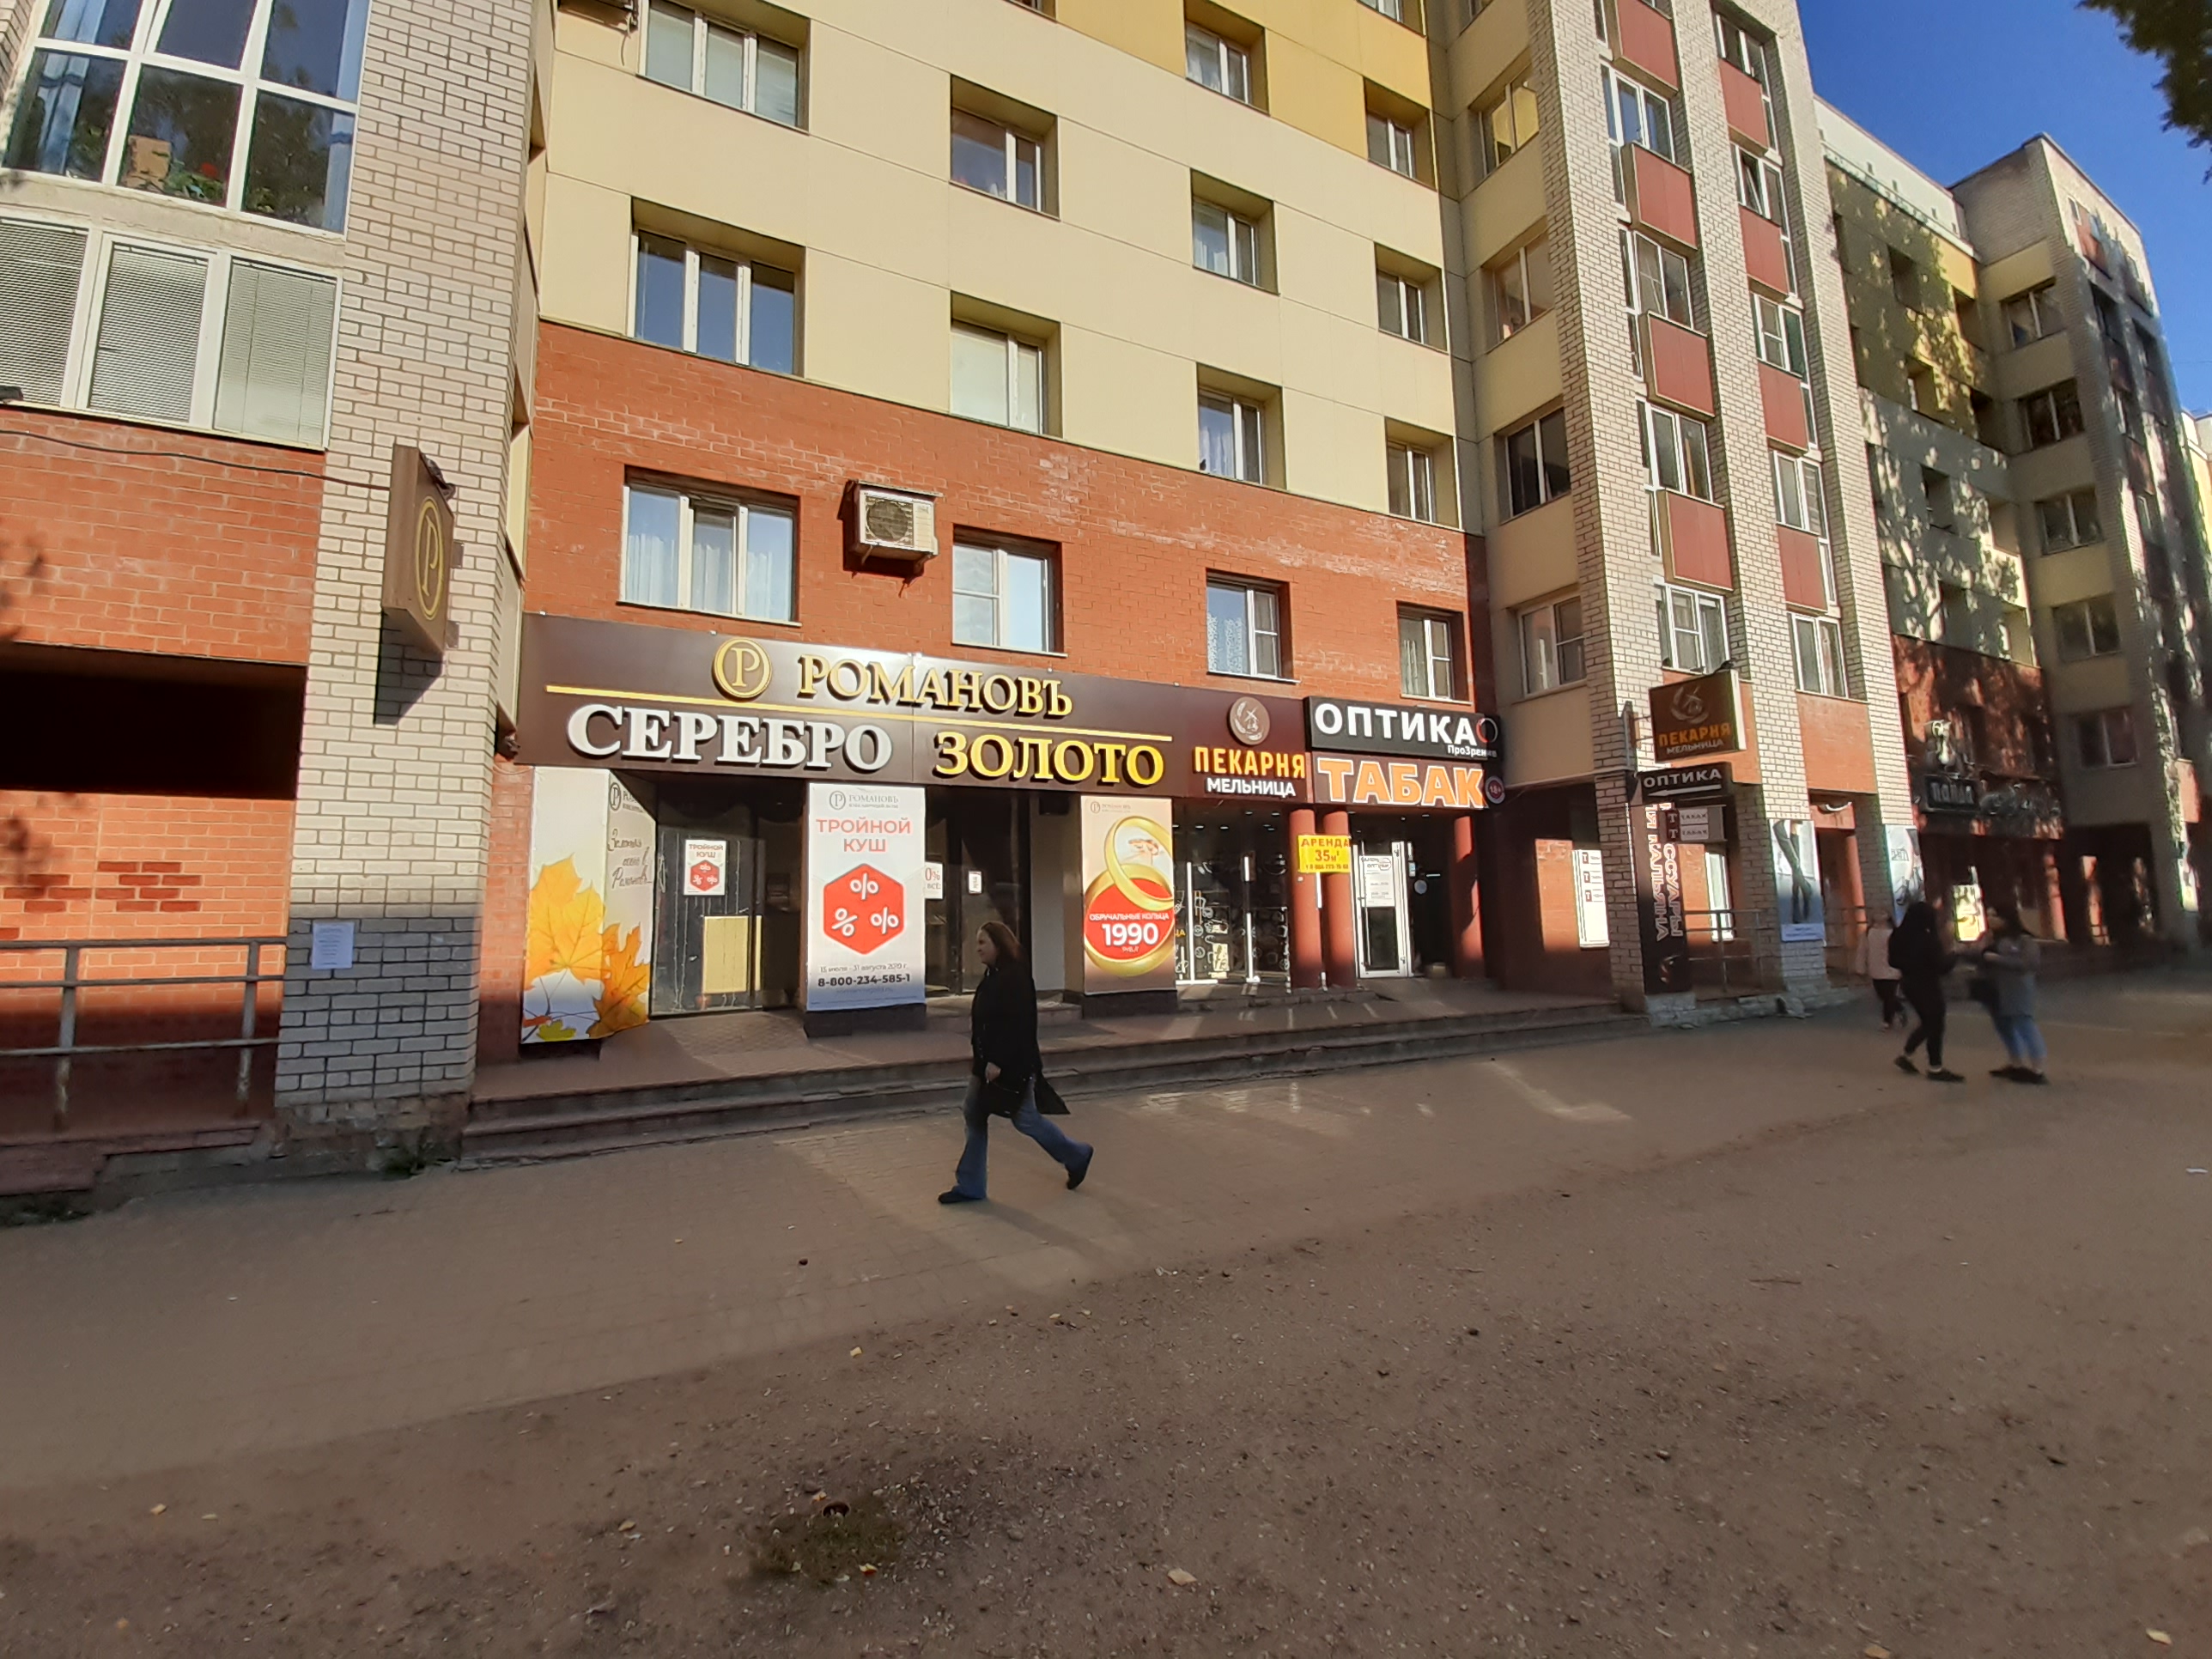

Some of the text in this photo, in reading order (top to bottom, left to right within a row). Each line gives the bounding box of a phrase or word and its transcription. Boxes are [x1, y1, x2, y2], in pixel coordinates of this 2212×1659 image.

[799, 654, 1073, 716] РОМАНОВЪ
[567, 704, 894, 771] СЕРЕБРО
[1315, 703, 1478, 746] ОПТИКА
[1658, 722, 1731, 748] ПЕКАРНЯ
[934, 732, 1164, 786] ЗОЛОТО
[1194, 746, 1306, 779] ПЕКАРНЯ
[1206, 777, 1297, 799] МЕЛЬНИЦА
[1317, 757, 1489, 810] ТАБАК
[1643, 769, 1723, 788] ОПТИКА
[816, 817, 911, 834] ТРОЙНОЙ
[843, 838, 886, 852] КУШ
[1301, 838, 1352, 848] АРЕНДА
[1102, 923, 1159, 946] 1990
